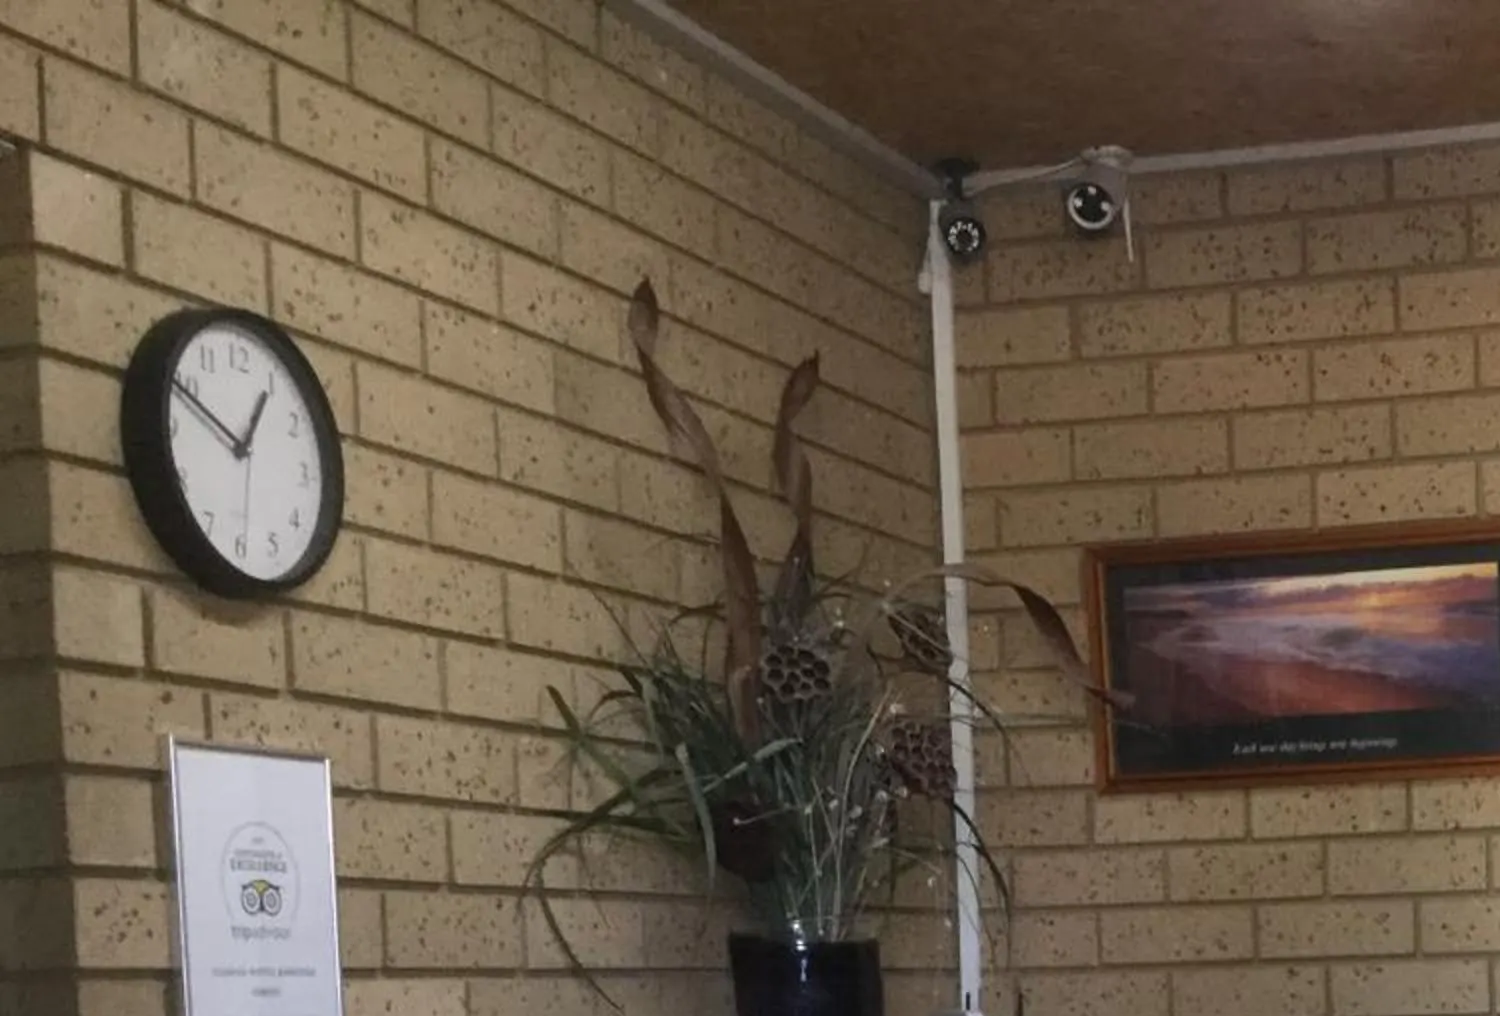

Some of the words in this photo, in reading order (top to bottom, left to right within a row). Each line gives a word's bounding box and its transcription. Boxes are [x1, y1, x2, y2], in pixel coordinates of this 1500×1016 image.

[200, 343, 216, 374] 11
[229, 342, 250, 374] 12
[287, 411, 299, 439] 2
[202, 510, 215, 538] 7
[288, 507, 300, 531] 4
[234, 534, 247, 560] 6
[266, 531, 279, 558] 5
